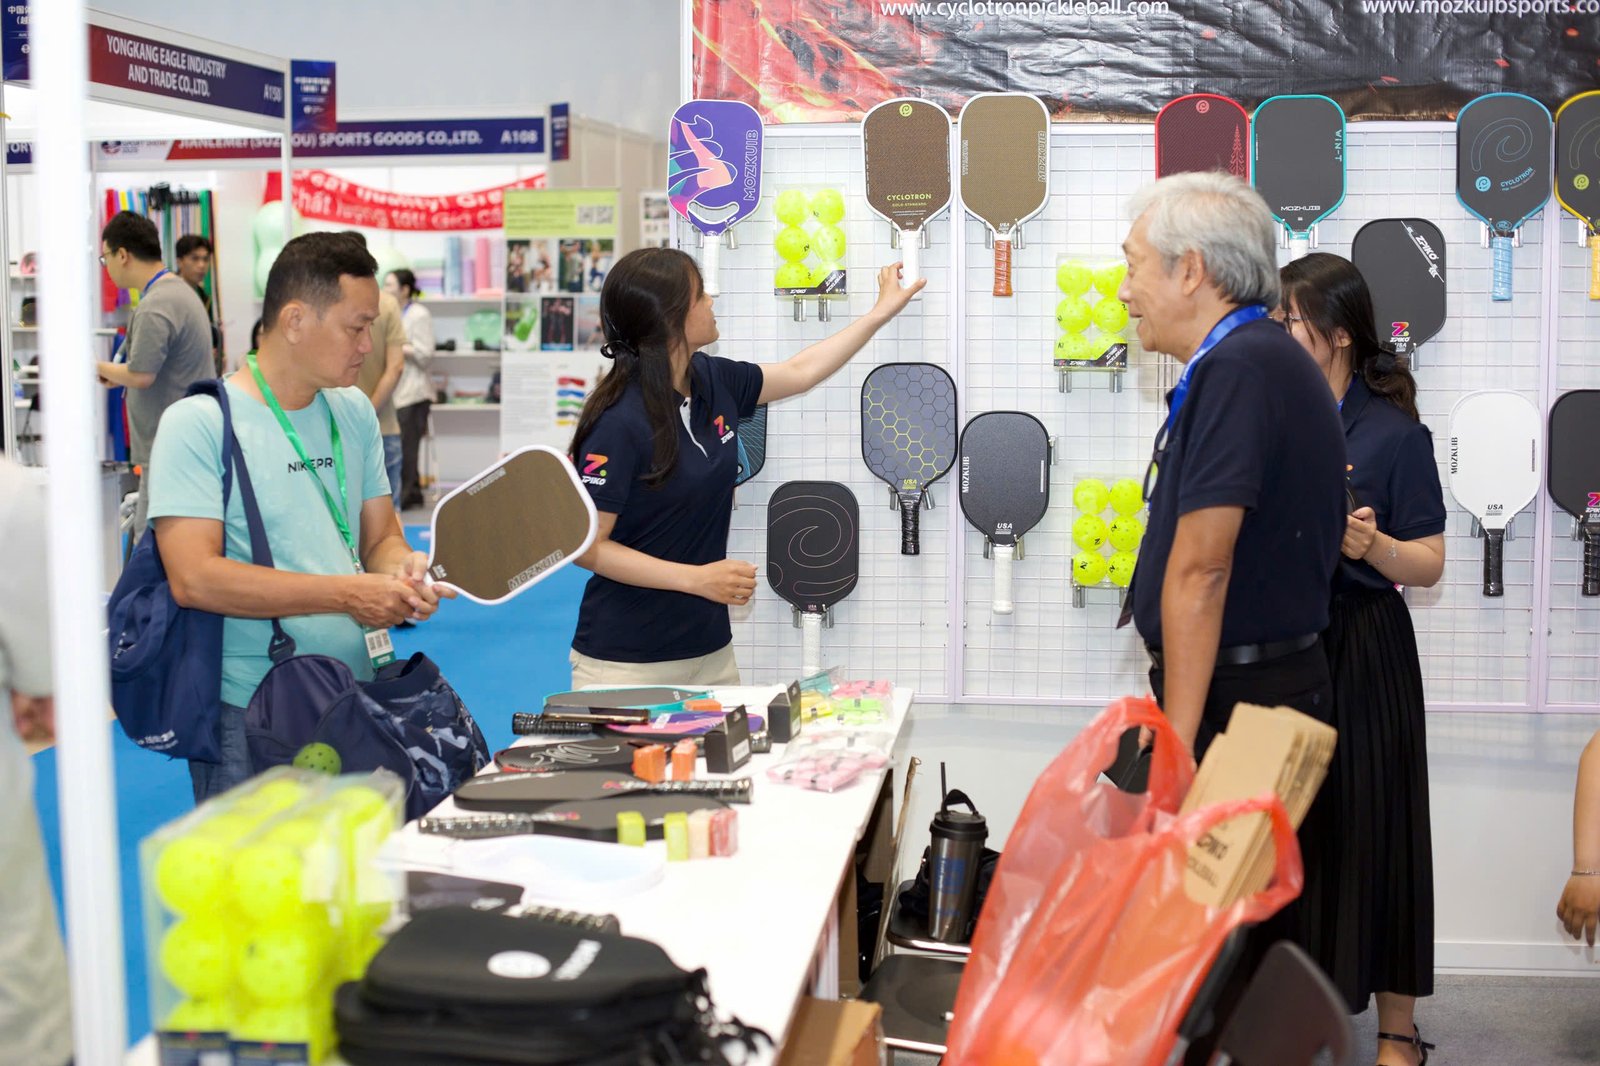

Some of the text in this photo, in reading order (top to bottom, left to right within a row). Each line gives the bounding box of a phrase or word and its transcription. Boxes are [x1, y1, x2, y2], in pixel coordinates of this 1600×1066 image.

[880, 0, 1169, 19] www.cyclotronpickleball.com
[1362, 0, 1600, 18] www.mozkuibsports.co
[106, 34, 227, 79] YONGKANG EAGLE INDUSTRY
[128, 63, 148, 84] AND
[148, 69, 177, 90] TRADE
[318, 131, 372, 148] SPORTS
[373, 131, 425, 146] GOODS
[743, 129, 759, 202] MOZKUIB
[1037, 130, 1047, 183] MOZKUIB
[1500, 166, 1534, 188] CYCLOTRON
[886, 193, 932, 201] CYCLOTRON
[1450, 437, 1458, 475] MOZKUIB
[961, 456, 970, 494] MOZKUIB
[507, 548, 565, 592] MOZKUIB
